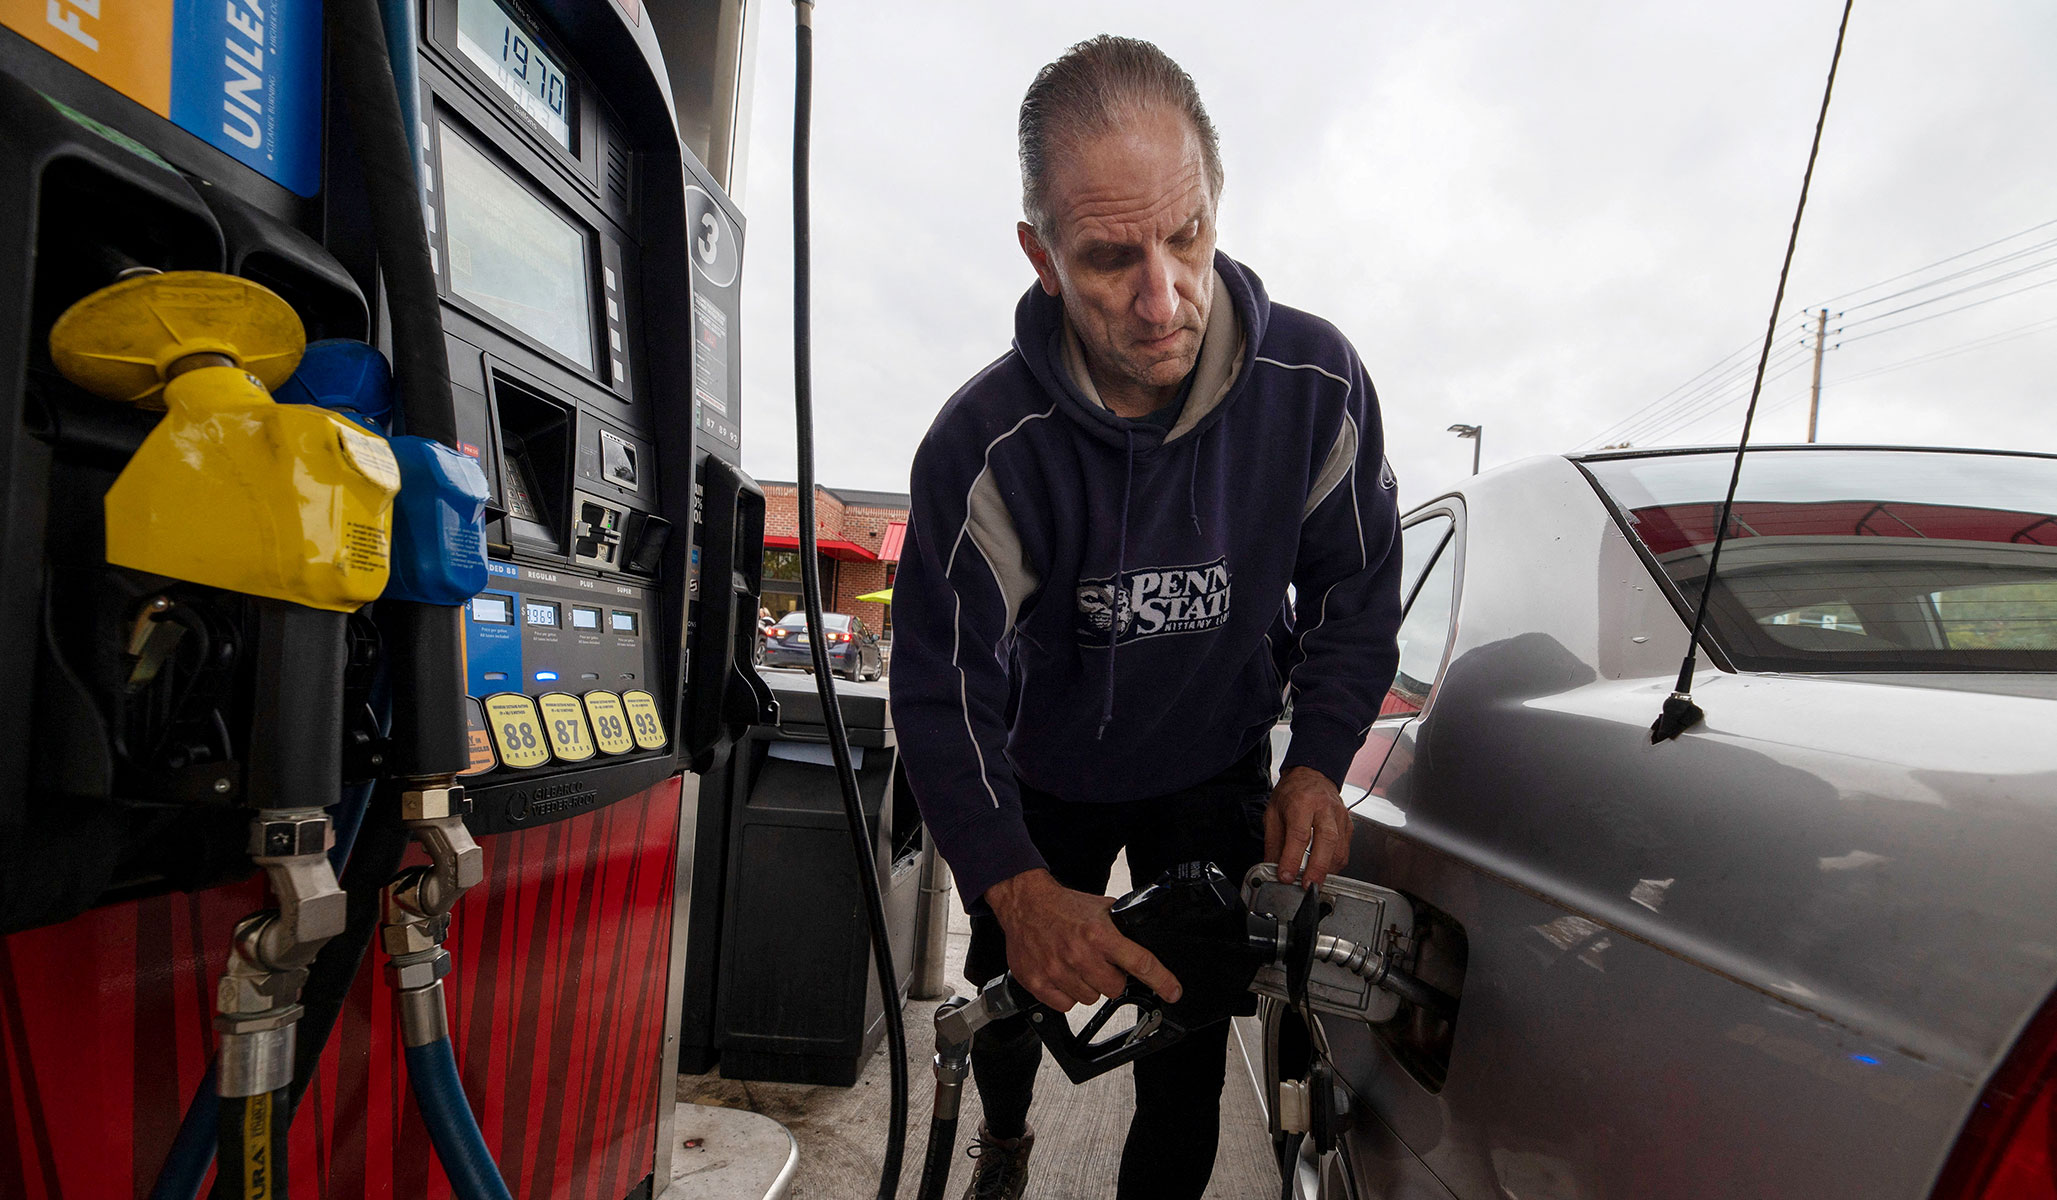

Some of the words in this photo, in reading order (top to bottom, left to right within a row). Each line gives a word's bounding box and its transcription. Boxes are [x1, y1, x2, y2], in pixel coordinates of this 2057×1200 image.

[503, 26, 564, 115] 19.70
[513, 103, 538, 130] Gallons
[698, 212, 719, 265] 3
[706, 417, 715, 429] 87
[719, 425, 727, 437] 89
[489, 564, 504, 573] DED
[506, 566, 517, 575] 88
[528, 571, 557, 582] REGULAR
[580, 580, 594, 588] PLUS
[617, 586, 632, 595] SUPER
[1131, 561, 1228, 612] PENN
[1165, 619, 1211, 632] NITTANY
[555, 719, 580, 745] 87
[598, 715, 622, 739] 89
[635, 713, 657, 735] 93
[504, 722, 536, 750] 88
[533, 781, 583, 801] GILBARCO
[532, 792, 597, 816] VEEDER-ROOT
